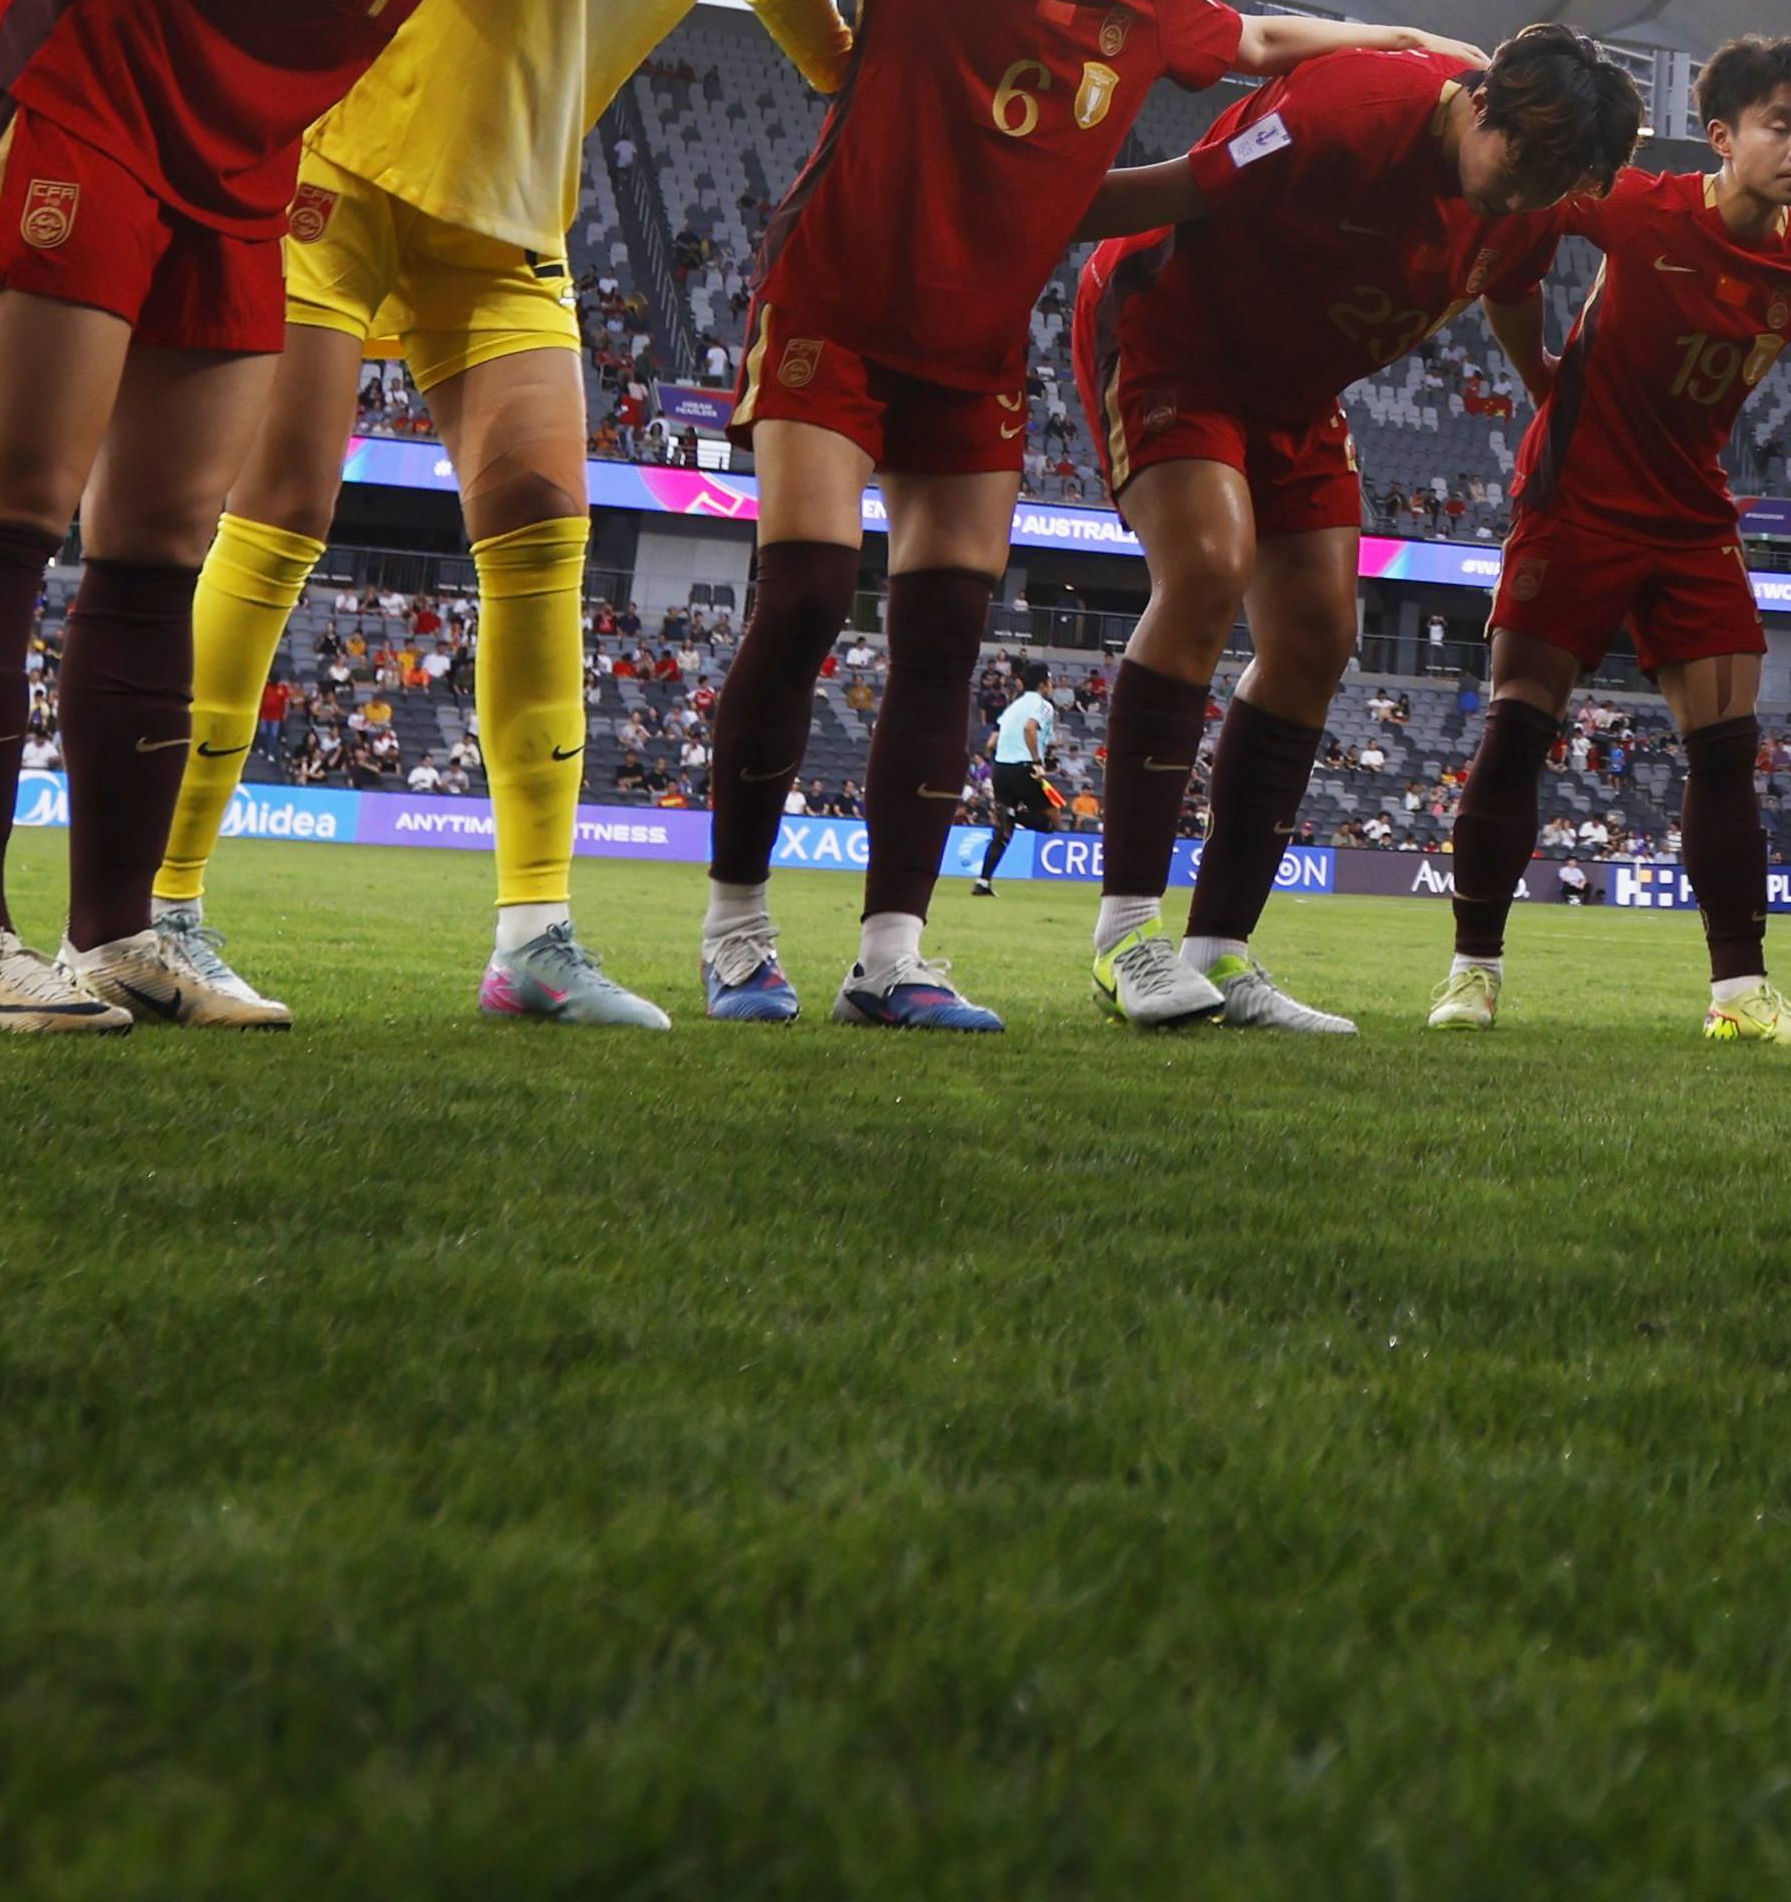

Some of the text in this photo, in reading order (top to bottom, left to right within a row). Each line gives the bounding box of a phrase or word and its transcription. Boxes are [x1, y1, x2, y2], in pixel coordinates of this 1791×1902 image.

[992, 59, 1052, 137] 6
[31, 184, 75, 200] CFA
[1671, 331, 1742, 405] 19
[219, 786, 337, 838] Midea
